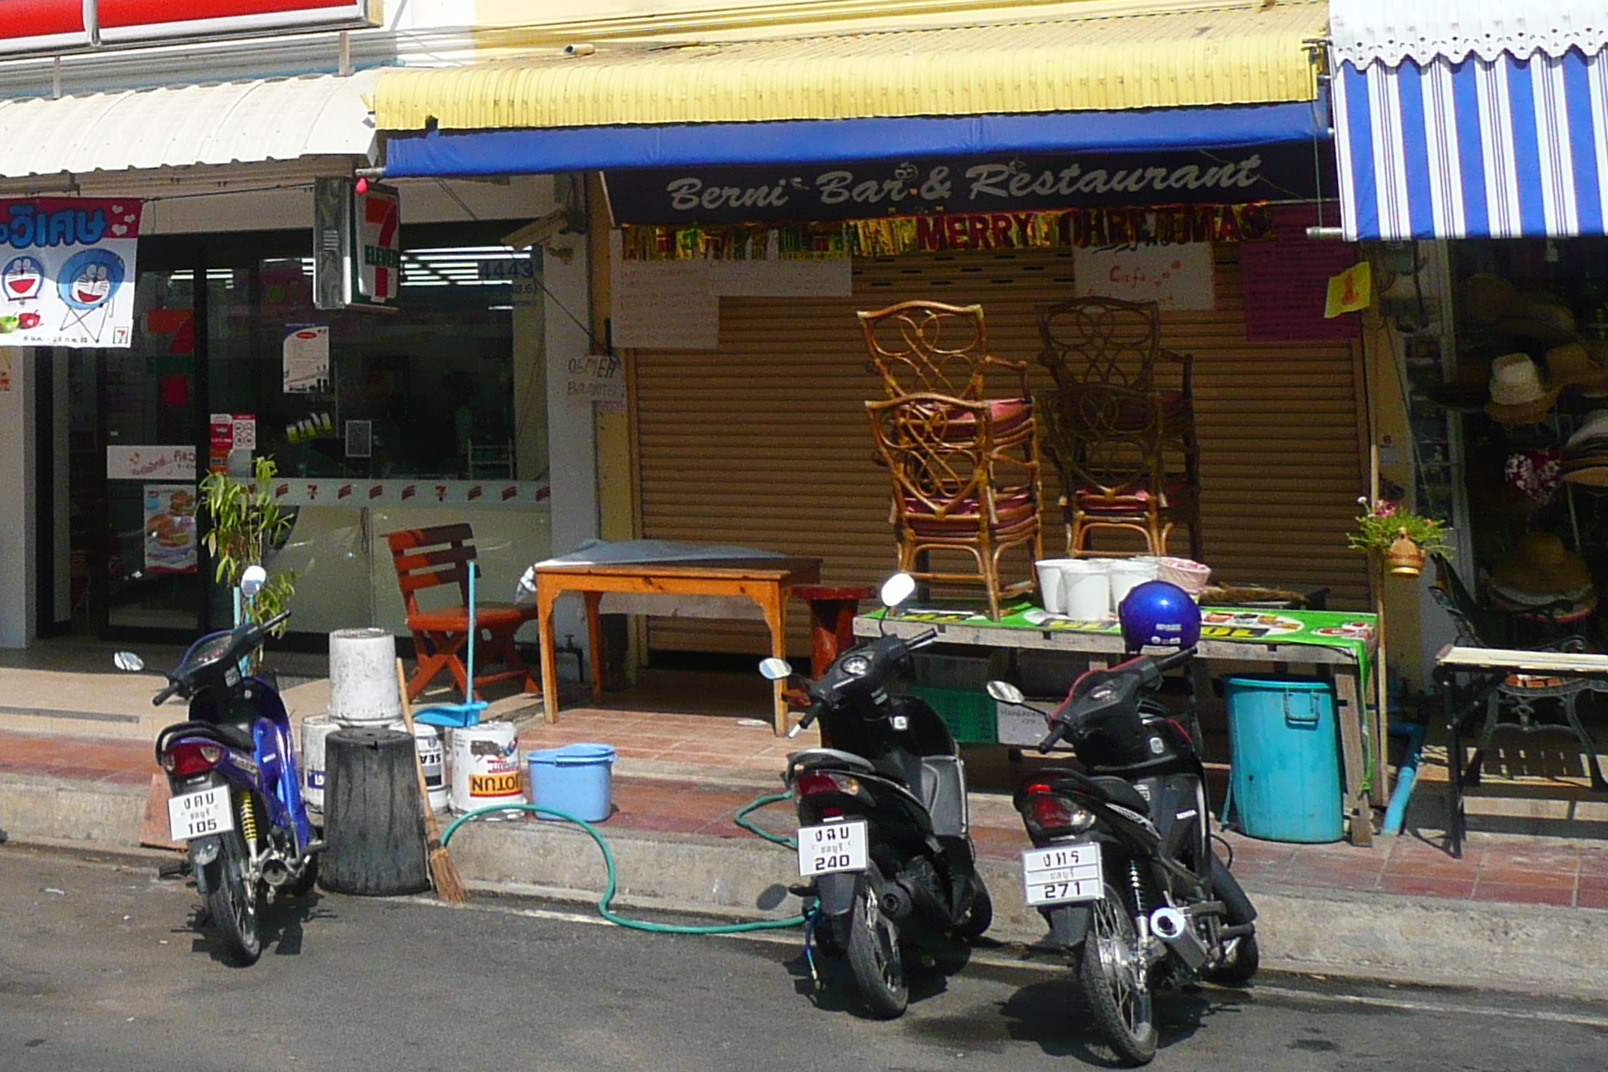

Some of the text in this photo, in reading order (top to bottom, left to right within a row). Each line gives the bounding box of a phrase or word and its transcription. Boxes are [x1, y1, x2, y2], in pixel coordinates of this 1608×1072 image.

[815, 170, 910, 205] Bar
[921, 164, 952, 201] &
[965, 154, 1263, 201] Restaurant
[917, 212, 1034, 250] MERRY
[472, 772, 520, 792] JOTUN
[188, 818, 217, 835] 105
[815, 854, 850, 871] 240
[1044, 881, 1080, 899] 271
